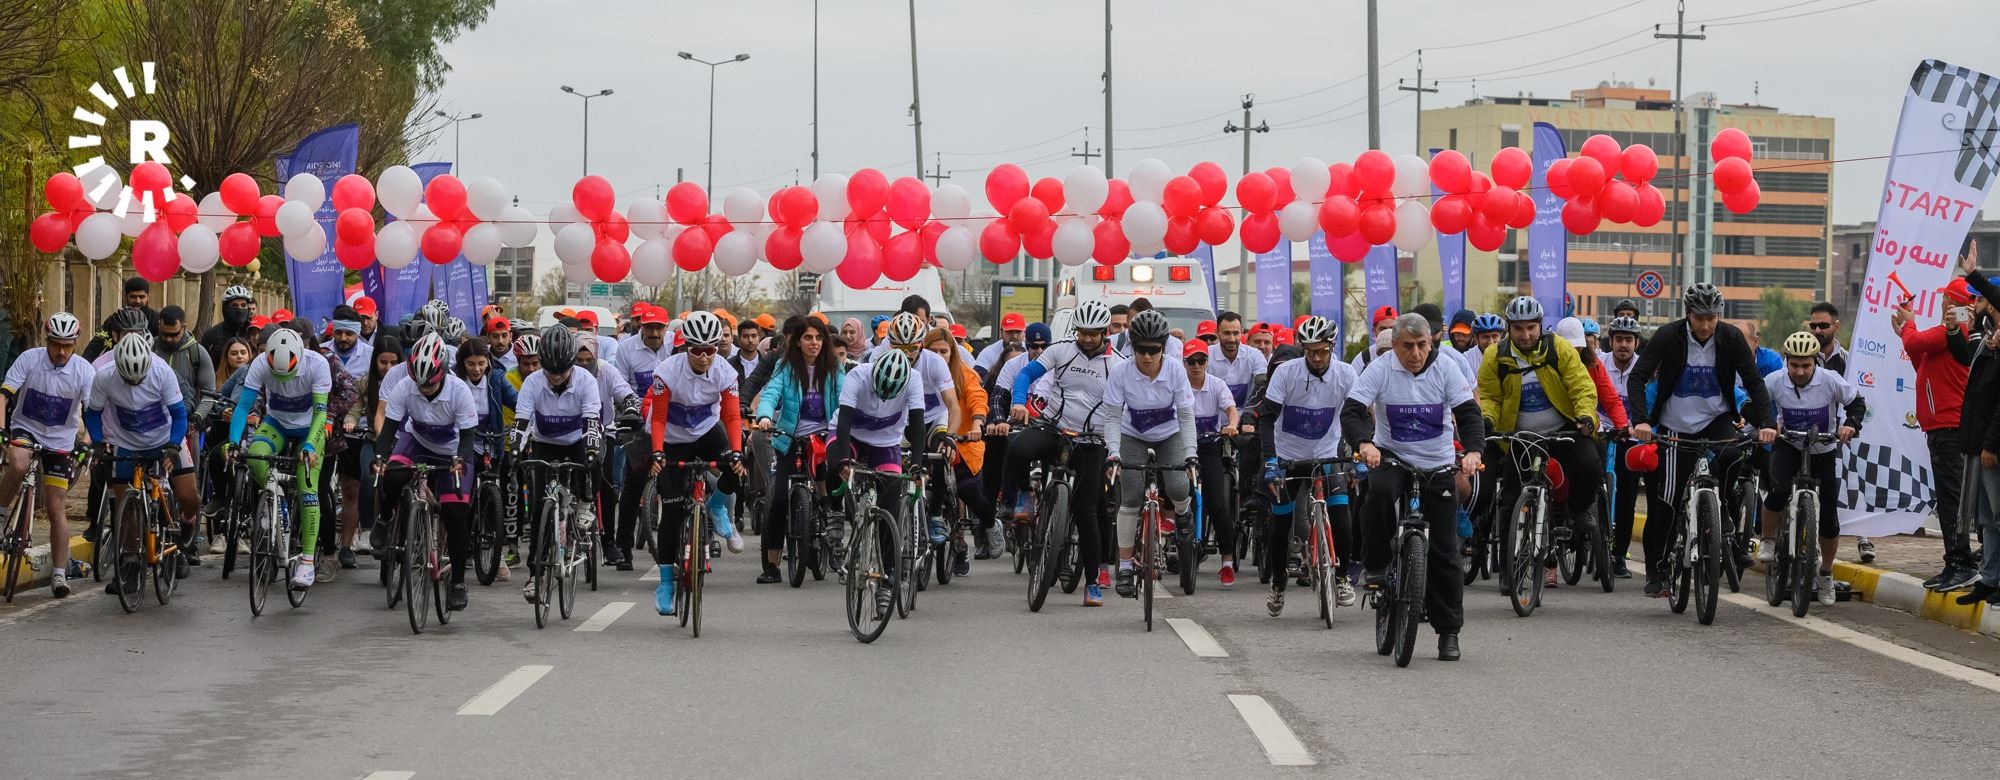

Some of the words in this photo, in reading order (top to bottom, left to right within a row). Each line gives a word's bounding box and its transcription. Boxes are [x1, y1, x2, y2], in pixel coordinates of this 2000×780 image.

[1528, 108, 1654, 131] MARIANA
[1718, 113, 1826, 137] HOTEL
[1864, 339, 1886, 354] IOM
[1070, 366, 1097, 376] CRAFT
[504, 481, 518, 538] dida
